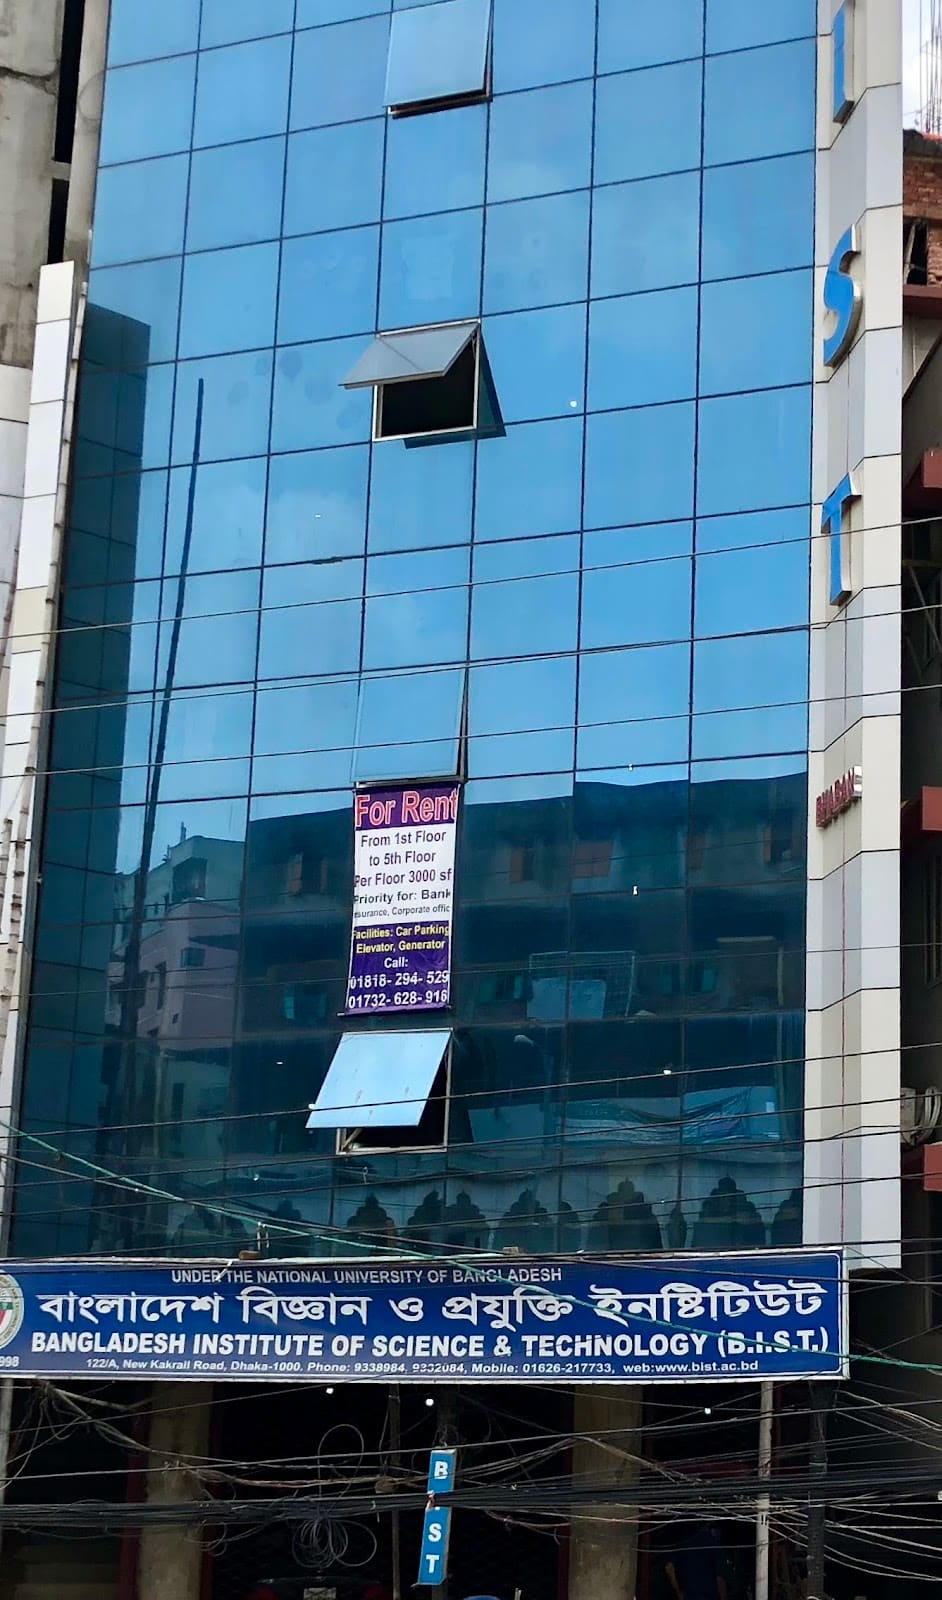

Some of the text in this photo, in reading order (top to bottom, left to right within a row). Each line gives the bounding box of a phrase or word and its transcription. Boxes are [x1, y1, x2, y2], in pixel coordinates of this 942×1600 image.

[356, 788, 458, 827] For Rent
[361, 831, 446, 848] From 1st Floor
[369, 851, 436, 866] to 5th Floor
[354, 868, 452, 888] Per Floor 3000 sf
[397, 890, 417, 901] for:
[392, 906, 430, 917] Corporate
[396, 926, 411, 937] Car
[414, 925, 450, 936] Parking
[356, 940, 445, 954] Elevator, Generator
[384, 957, 408, 969] Call:
[426, 971, 450, 984] 529
[348, 993, 392, 1009] 01732-
[172, 1267, 562, 1283] UNDER THE NATIONAL UNIVERSITY OF BANGLADESH
[36, 1290, 225, 1324] বাংলাদেশ
[236, 1286, 373, 1325] বিজ্ঞান
[389, 1297, 424, 1322] ও
[442, 1286, 576, 1332] প্রযুক্তি
[31, 1332, 187, 1354] BANGLADESH
[193, 1334, 324, 1356] INSTITUTE
[331, 1335, 365, 1357] OF
[372, 1335, 485, 1357] SCIENCE
[494, 1335, 512, 1357] &
[522, 1333, 708, 1357] TECHNOLOGY
[86, 1358, 120, 1370] 122/A,
[123, 1359, 148, 1369] New
[151, 1358, 190, 1370] Kakrail
[193, 1359, 227, 1371] Road,
[307, 1362, 351, 1373] Phone:
[471, 1362, 519, 1373] Mobile:
